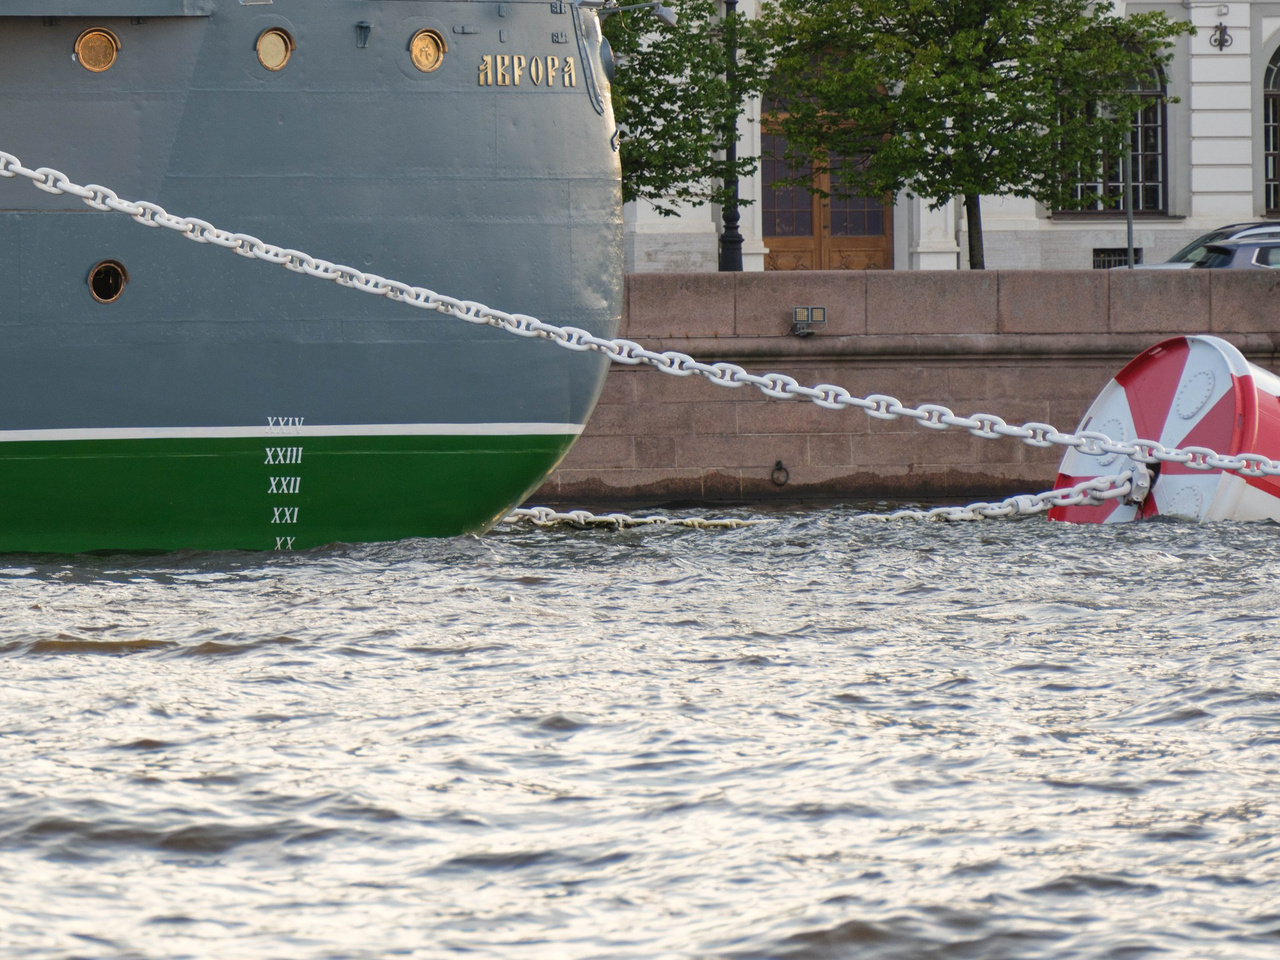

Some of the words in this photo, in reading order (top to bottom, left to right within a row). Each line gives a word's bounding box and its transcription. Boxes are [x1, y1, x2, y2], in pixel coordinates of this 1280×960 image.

[478, 55, 576, 87] АВРОРА
[265, 416, 305, 434] XXIV
[264, 447, 303, 464] XXIII
[268, 477, 301, 493] XXII
[271, 507, 299, 523] XXI
